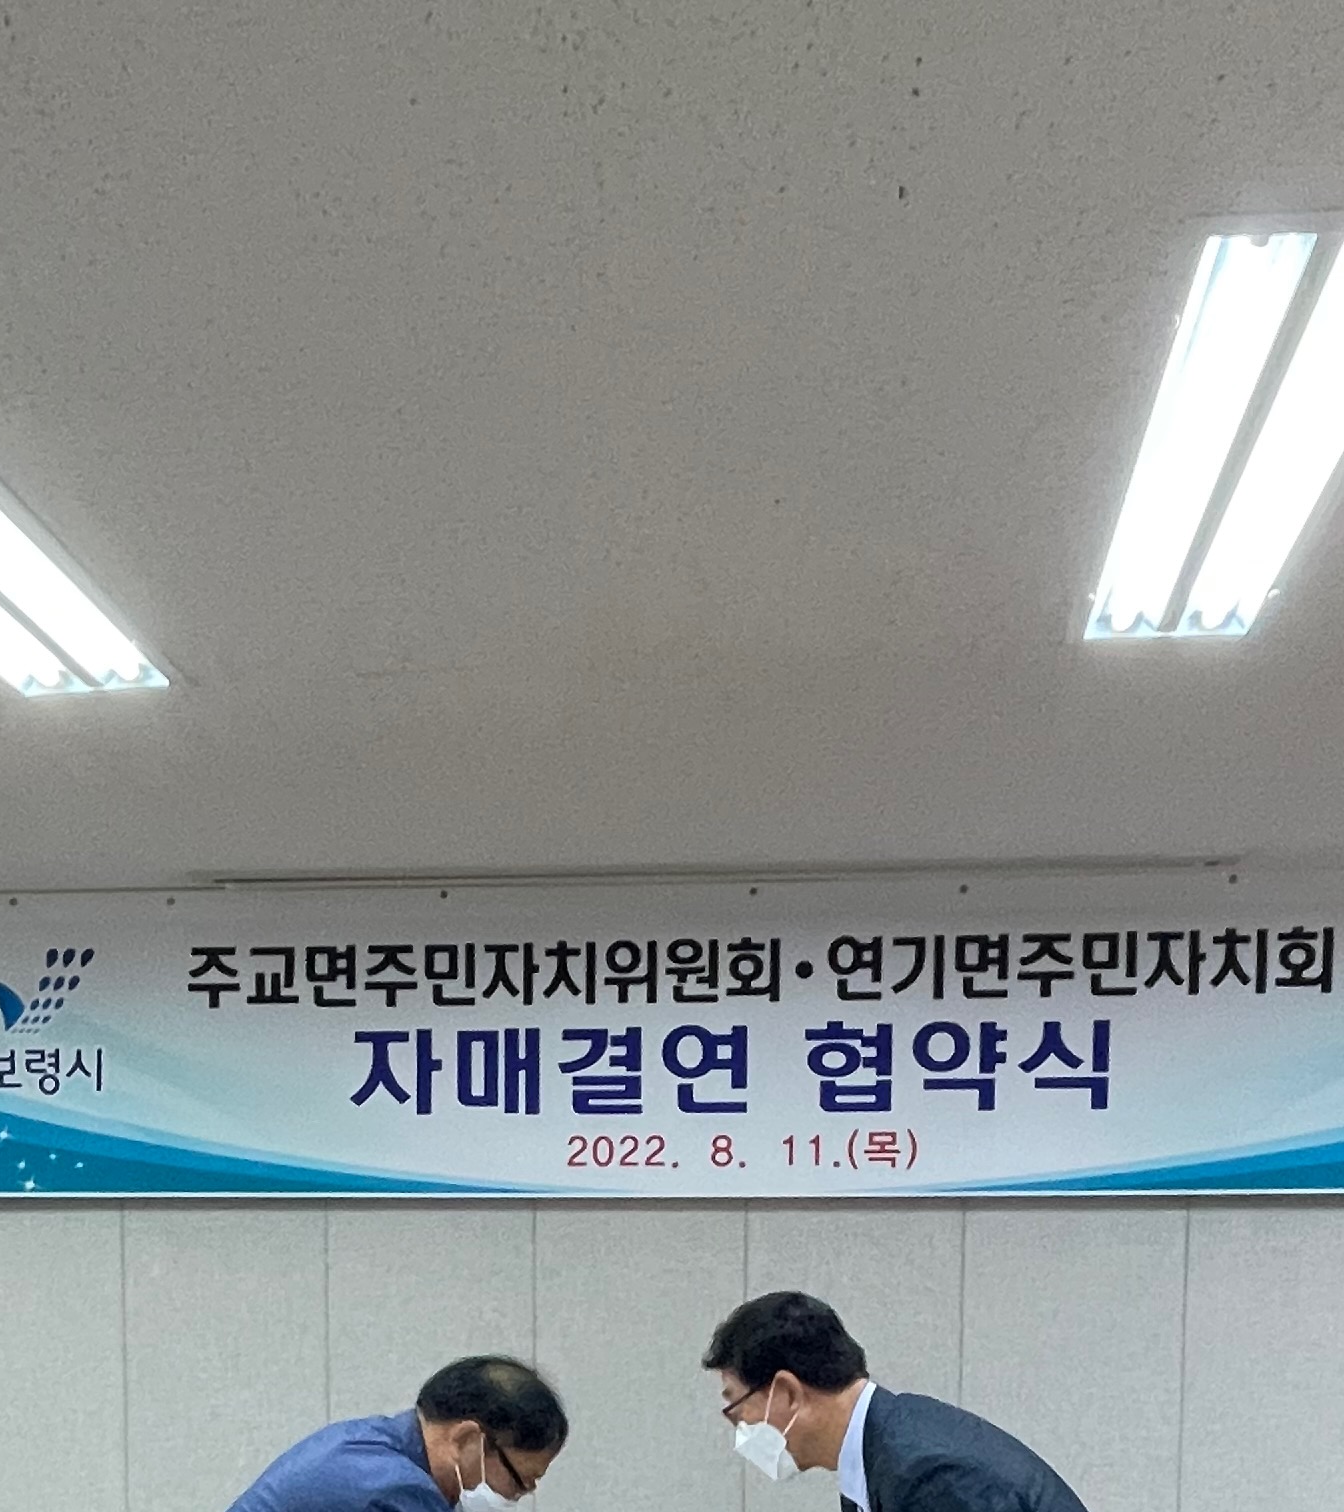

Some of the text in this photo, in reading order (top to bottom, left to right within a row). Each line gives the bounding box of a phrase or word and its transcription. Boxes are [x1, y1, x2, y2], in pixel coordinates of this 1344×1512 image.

[350, 1020, 1111, 1115] 자매결연 협약식
[567, 1134, 679, 1169] 2022.
[710, 1134, 746, 1169] 8.
